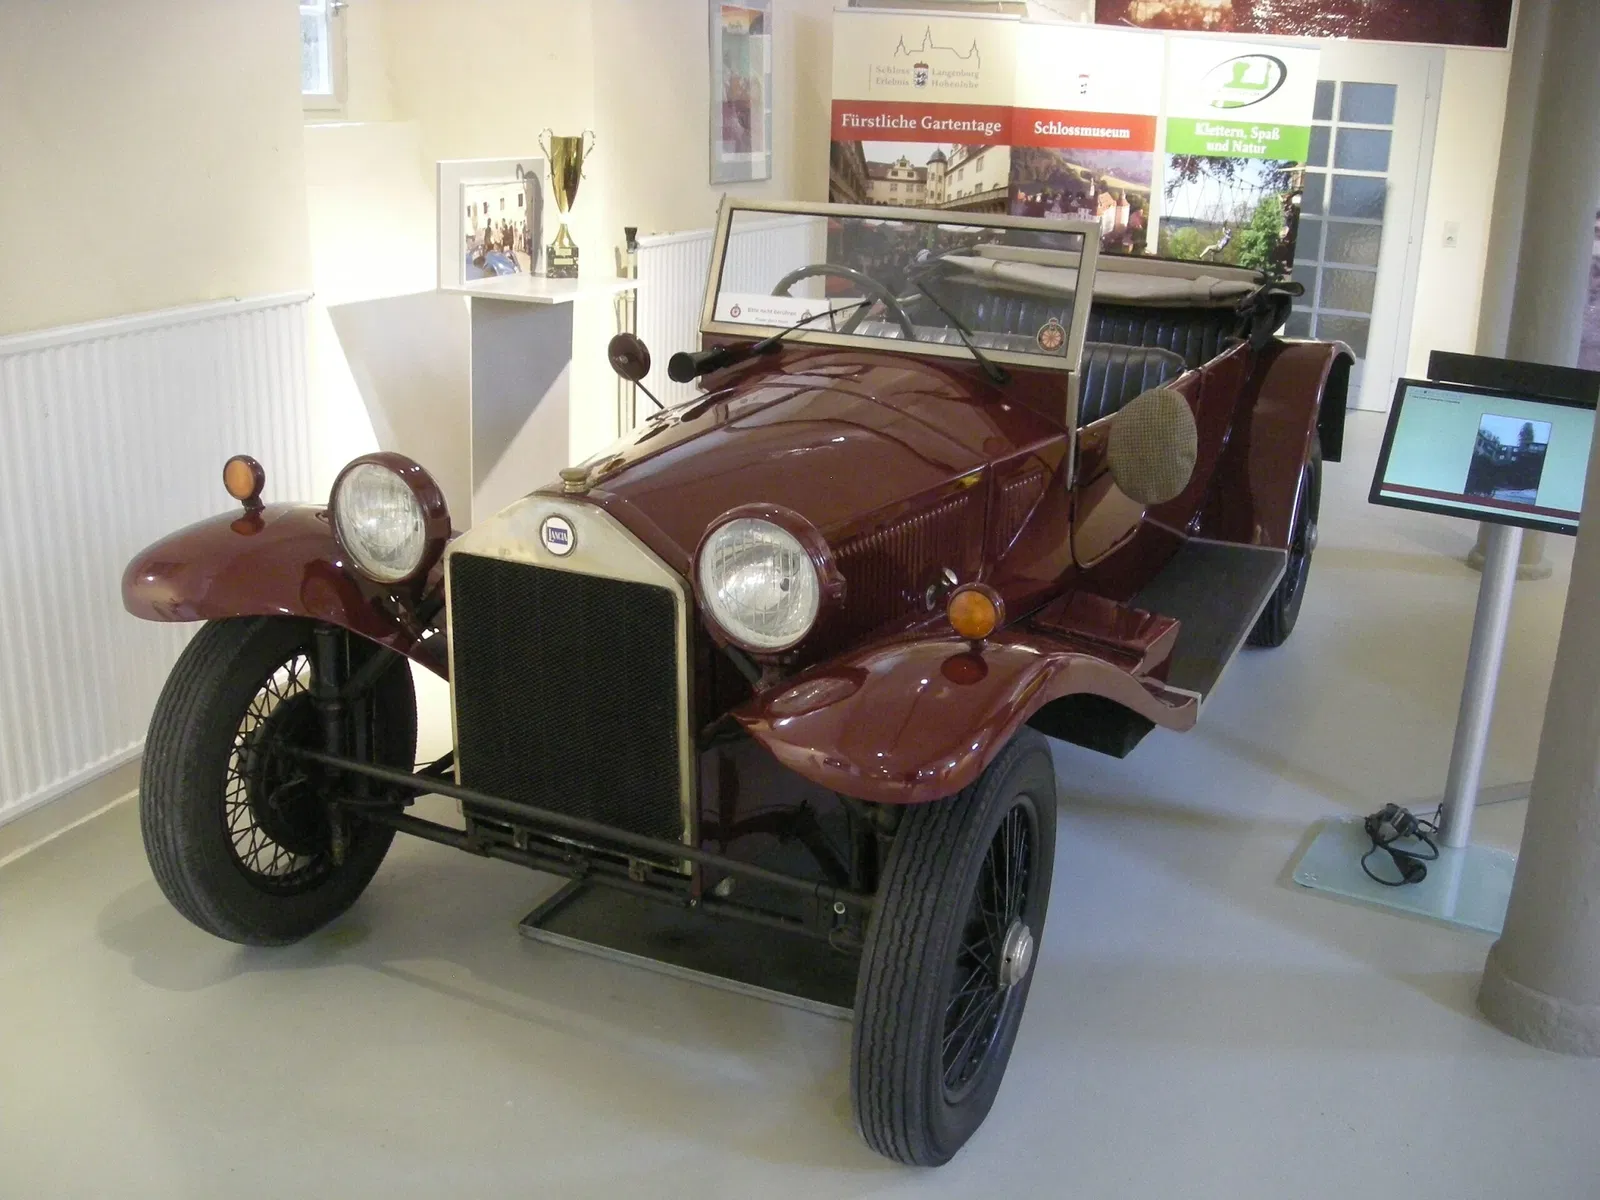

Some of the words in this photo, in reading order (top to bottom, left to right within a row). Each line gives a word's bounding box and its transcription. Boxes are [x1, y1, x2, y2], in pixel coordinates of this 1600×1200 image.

[875, 65, 910, 75] Schloss
[932, 68, 980, 79] Langenburg
[875, 77, 910, 86] Erlebnis
[841, 113, 918, 129] Fürstliche
[921, 116, 1002, 136] Gartentage
[1034, 120, 1131, 139] Schlossmuseum
[1195, 121, 1248, 139] Klettern,
[1250, 126, 1280, 144] Spaß
[1206, 139, 1230, 152] und
[1232, 140, 1267, 154] Natur
[548, 528, 568, 544] LANCIA
